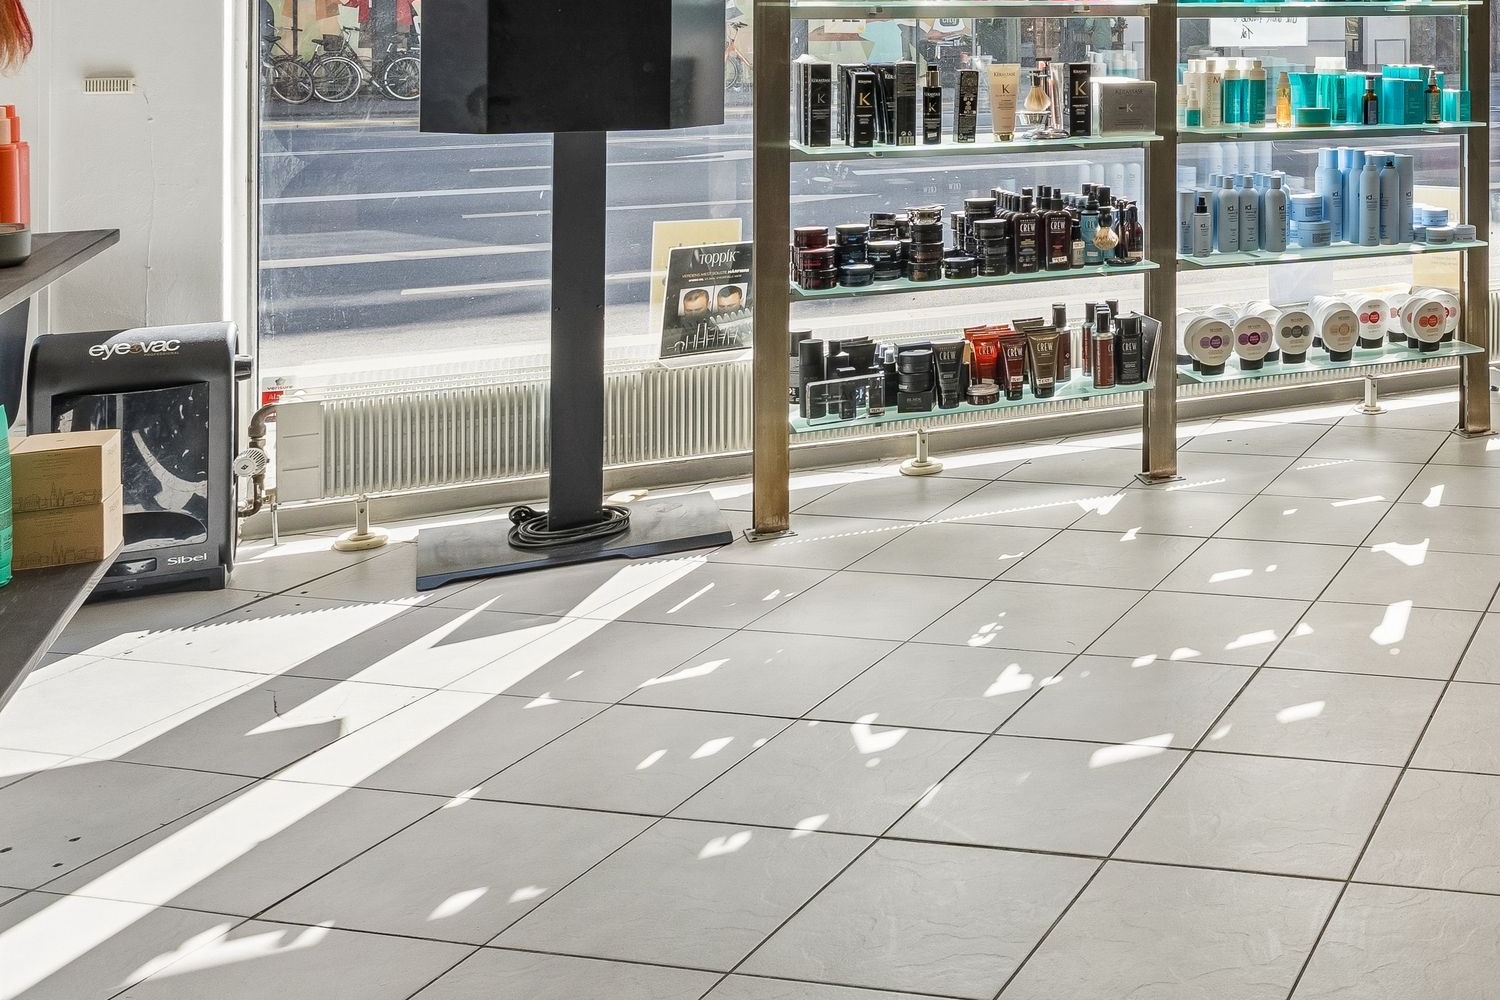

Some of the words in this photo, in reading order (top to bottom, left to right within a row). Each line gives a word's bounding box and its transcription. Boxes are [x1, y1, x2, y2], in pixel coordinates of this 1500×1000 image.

[1002, 84, 1010, 93] K
[1074, 81, 1086, 96] K
[859, 92, 871, 106] K
[1020, 223, 1036, 232] CREW
[1051, 221, 1066, 230] CREW
[1037, 342, 1053, 351] CREW
[1007, 348, 1023, 357] CREW
[167, 552, 208, 567] Sibel
